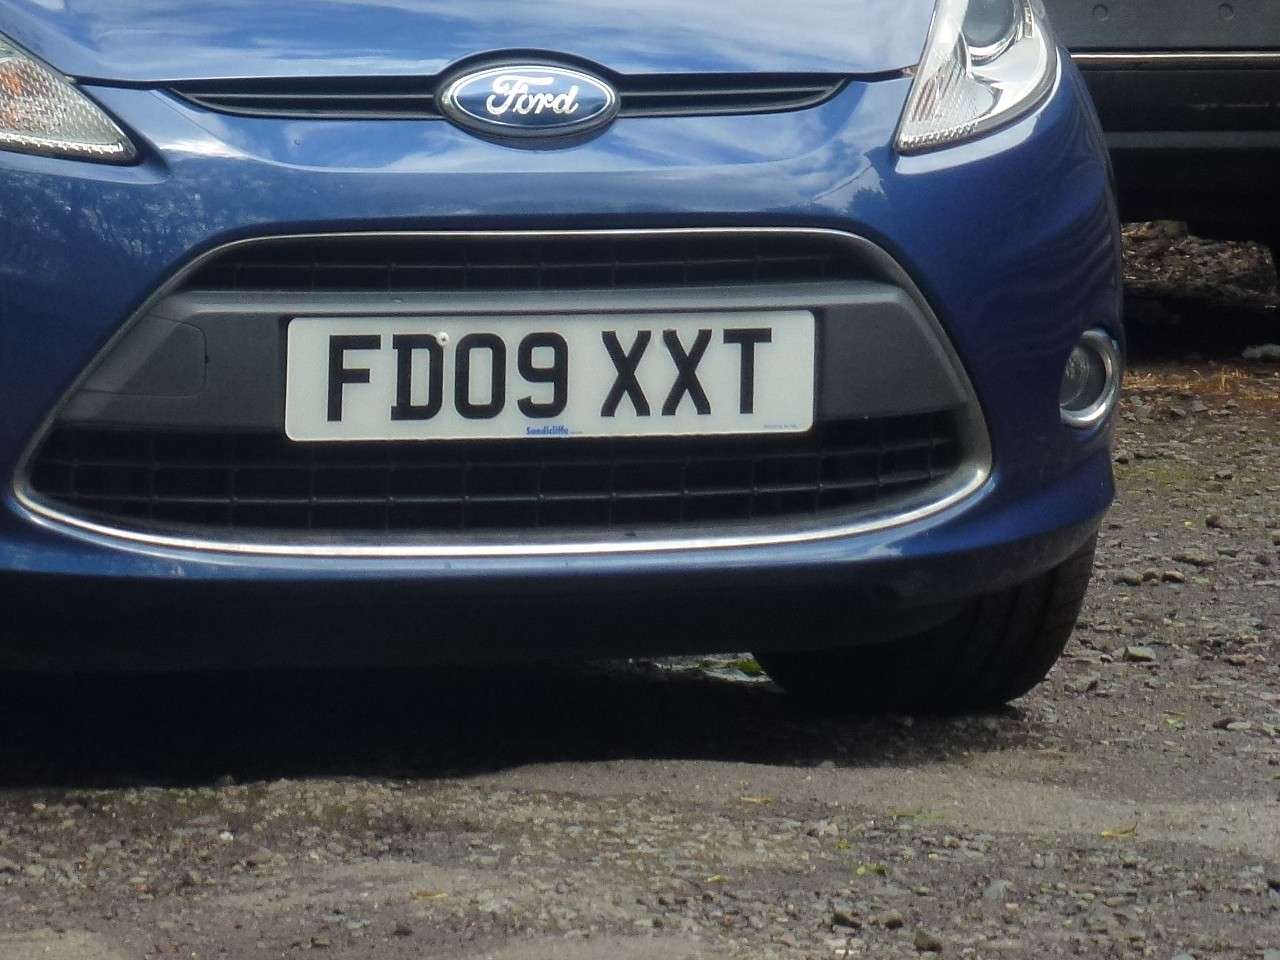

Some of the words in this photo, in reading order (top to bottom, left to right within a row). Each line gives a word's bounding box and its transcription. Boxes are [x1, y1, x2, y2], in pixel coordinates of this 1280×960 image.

[486, 75, 579, 115] Ford
[326, 332, 569, 421] FD09
[600, 327, 773, 417] XXT
